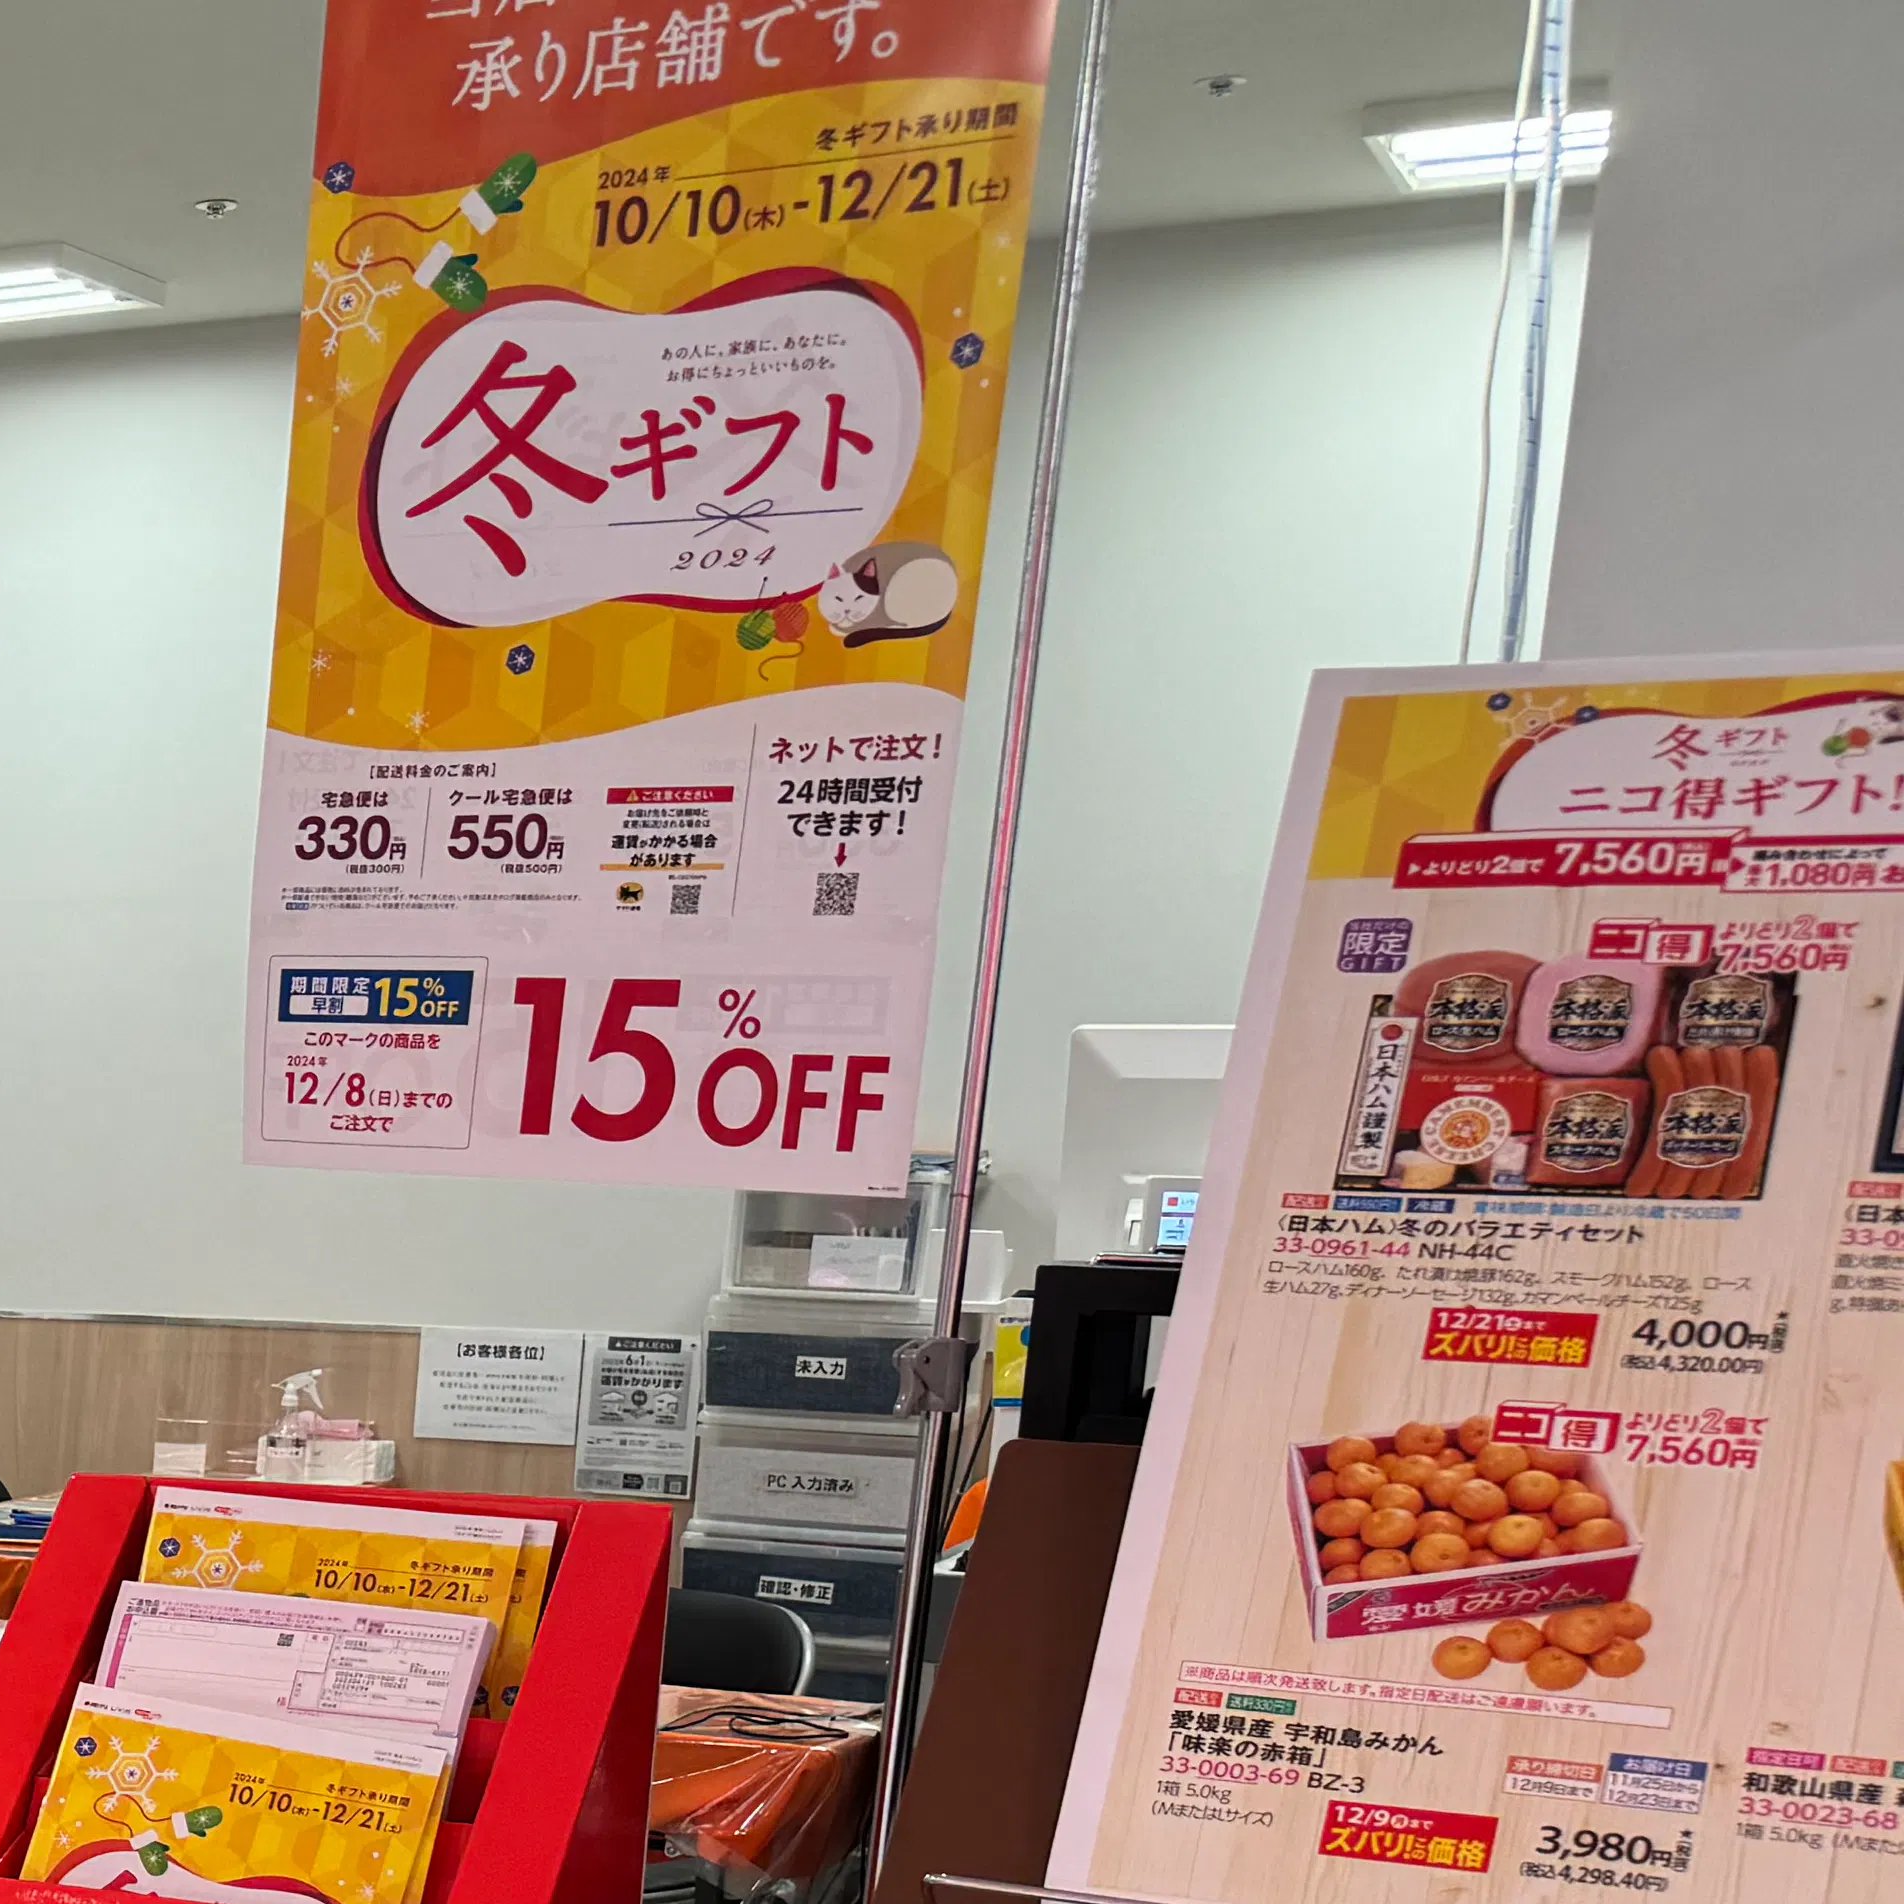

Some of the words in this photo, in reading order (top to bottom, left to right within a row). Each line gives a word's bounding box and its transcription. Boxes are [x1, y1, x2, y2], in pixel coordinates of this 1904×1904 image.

[815, 102, 1019, 152] 冬ギフト承り期間
[597, 164, 671, 191] 2024年
[405, 339, 875, 578] 冬ギフト
[669, 543, 778, 571] 2024
[1652, 724, 1790, 770] 冬ギフト
[321, 790, 389, 808] 宅急便は
[447, 788, 573, 808] クール宅急便は
[778, 777, 924, 806] 24時間受付
[294, 814, 407, 862] 330円
[447, 813, 565, 862] 550円
[1343, 931, 1409, 957] 限定
[290, 977, 371, 996] 期間限定
[310, 998, 345, 1014] 早割
[374, 977, 419, 1018] 15
[420, 1000, 460, 1019] OFF
[303, 1031, 442, 1051] このマークの商品を
[513, 978, 682, 1143] 15
[697, 1047, 893, 1154] OFF
[330, 1115, 395, 1134] ご注文で
[1418, 1243, 1516, 1262] NH-44C
[1626, 1434, 1761, 1470] 7,560円
[766, 1474, 787, 1490] PC
[790, 1475, 855, 1495] 入力済み
[1170, 1709, 1275, 1739] 愛媛県産
[1284, 1722, 1444, 1757] 宇和島みかん
[1159, 1755, 1301, 1786] 33-0003-69
[1307, 1772, 1366, 1794] BZ-3
[1742, 1772, 1884, 1806] 和歌山県産
[1186, 1783, 1232, 1804] 5.0kg
[1737, 1796, 1899, 1830] 33-0023-68
[1535, 1825, 1673, 1868] 3,980円
